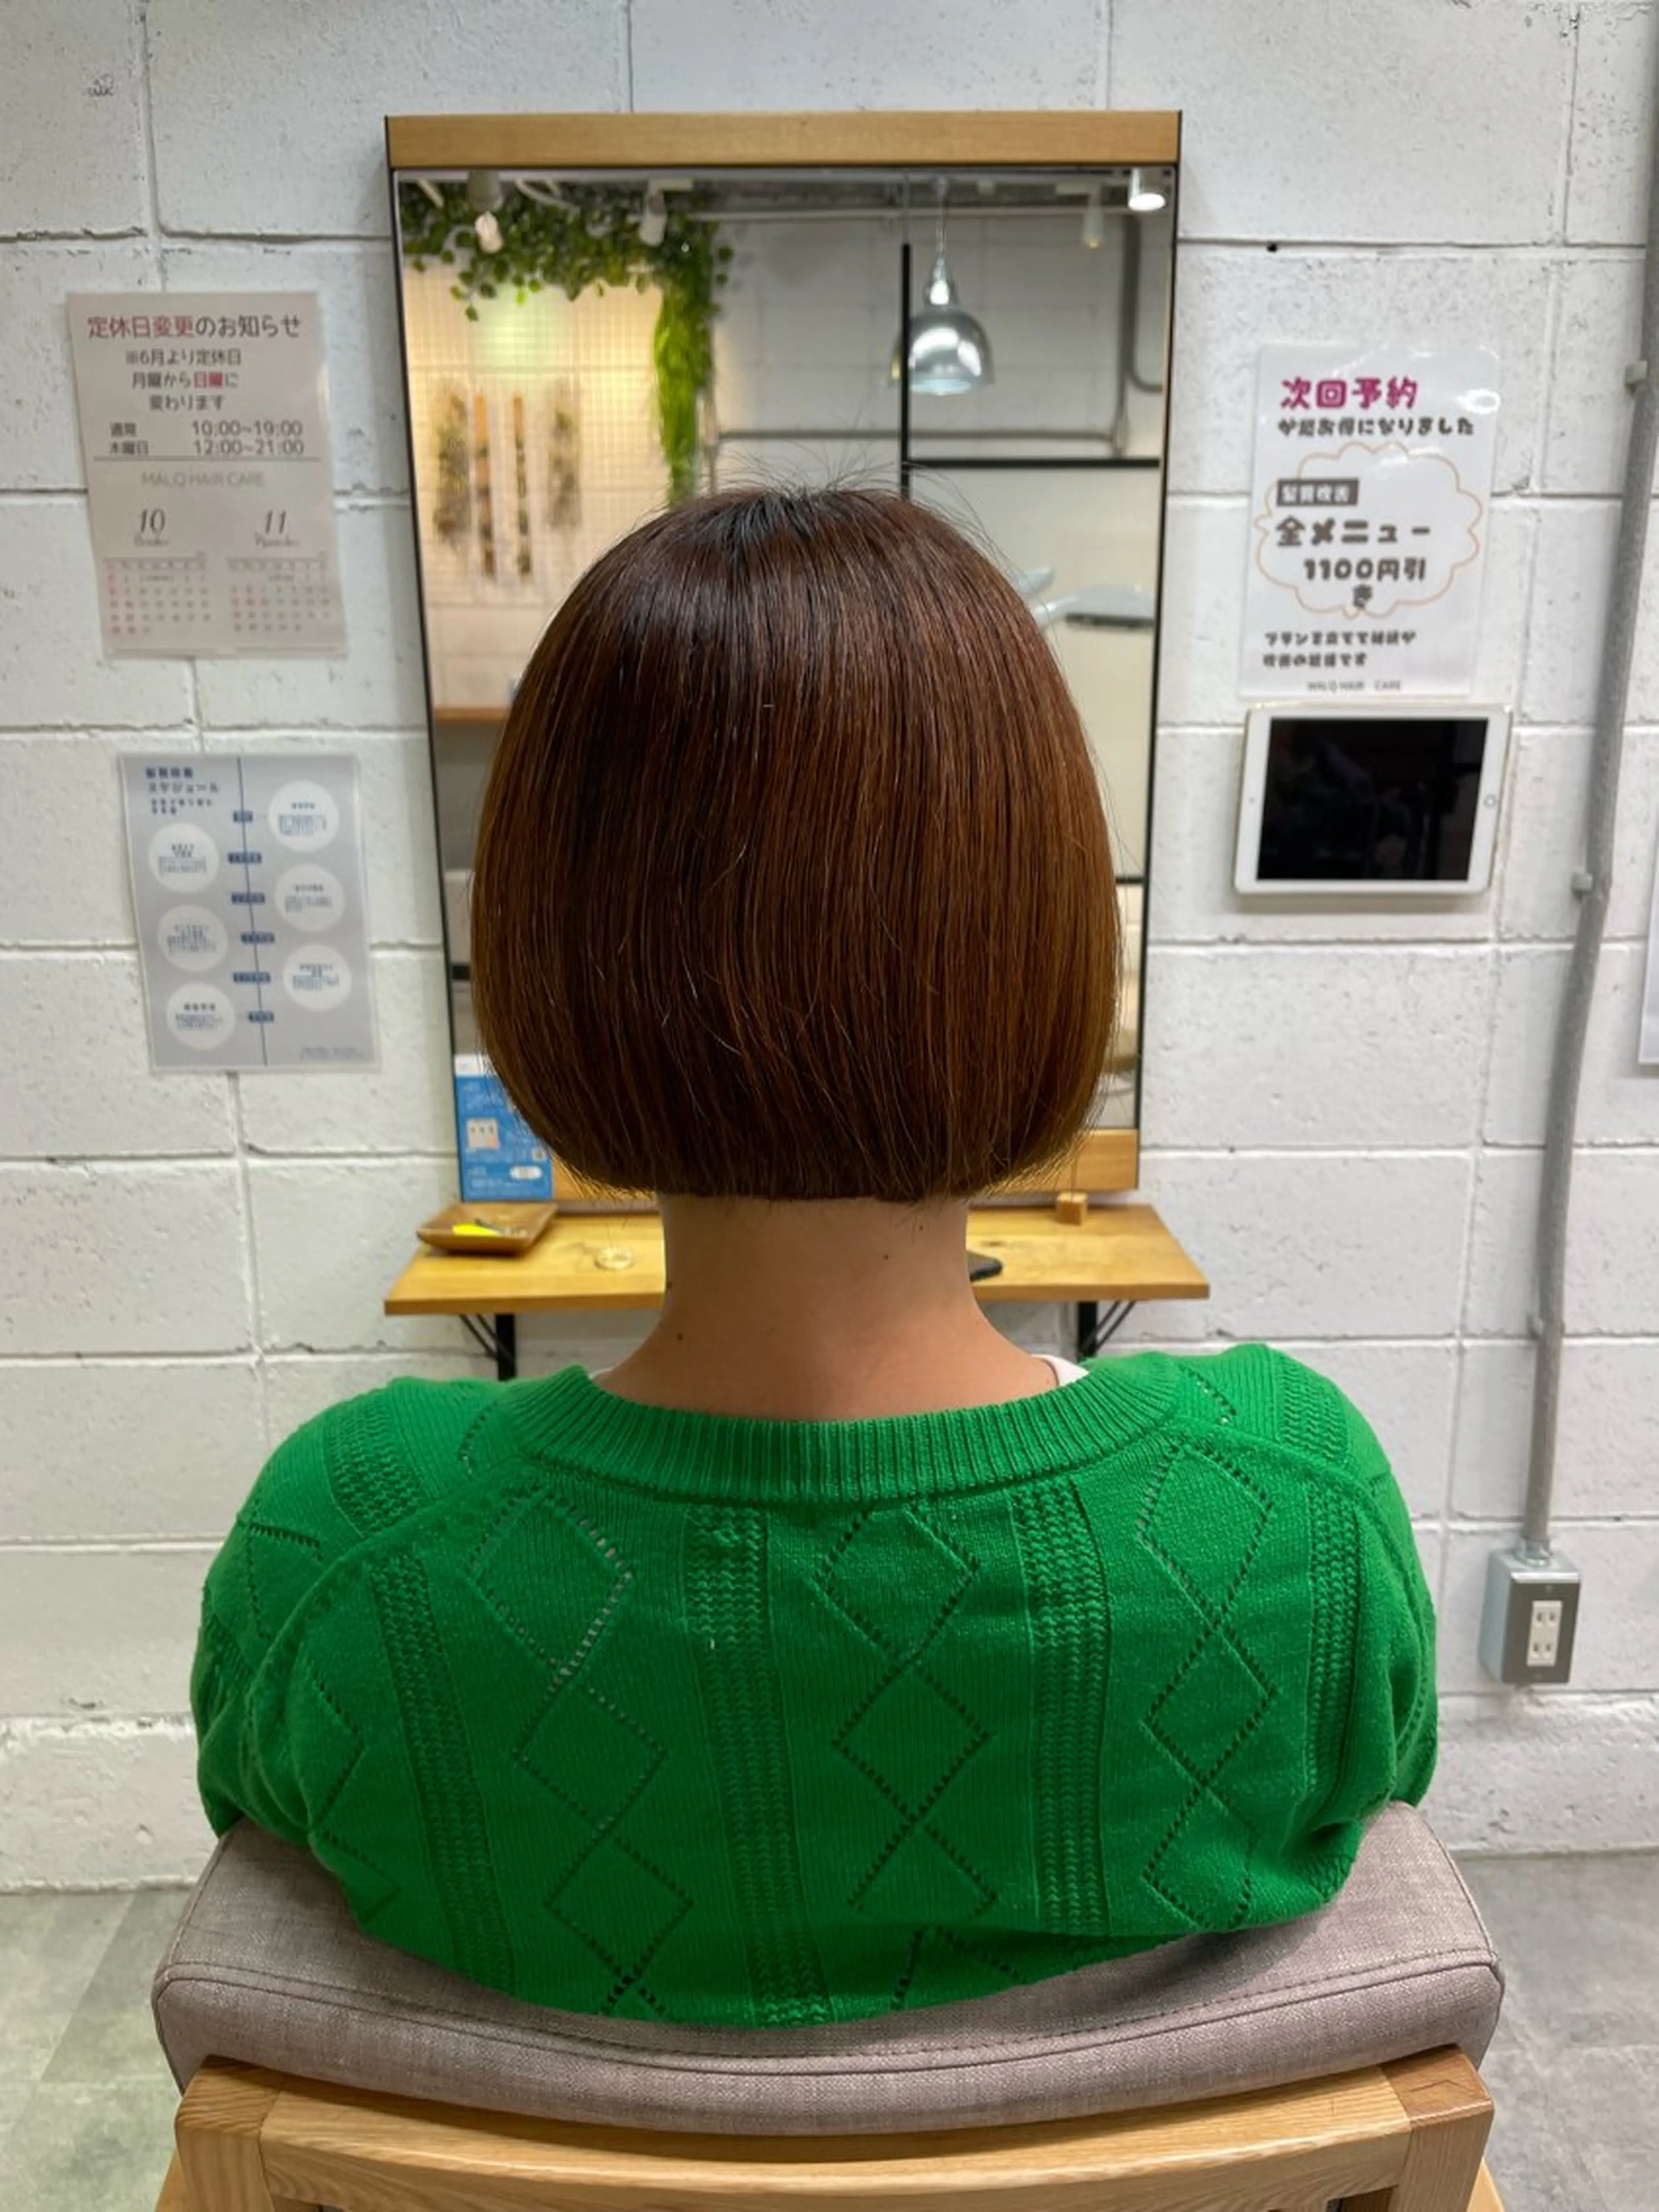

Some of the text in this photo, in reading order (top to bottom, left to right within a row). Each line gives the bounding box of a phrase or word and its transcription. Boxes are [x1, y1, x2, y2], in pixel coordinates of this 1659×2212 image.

[87, 315, 301, 339] 定休日変更のお知らせ
[133, 372, 238, 389] 月曜から日曜に
[149, 394, 223, 411] 変わります
[1281, 376, 1417, 410] 次回予約
[140, 508, 165, 534] 10
[265, 510, 286, 534] 11
[1275, 515, 1431, 547] 全メニュー
